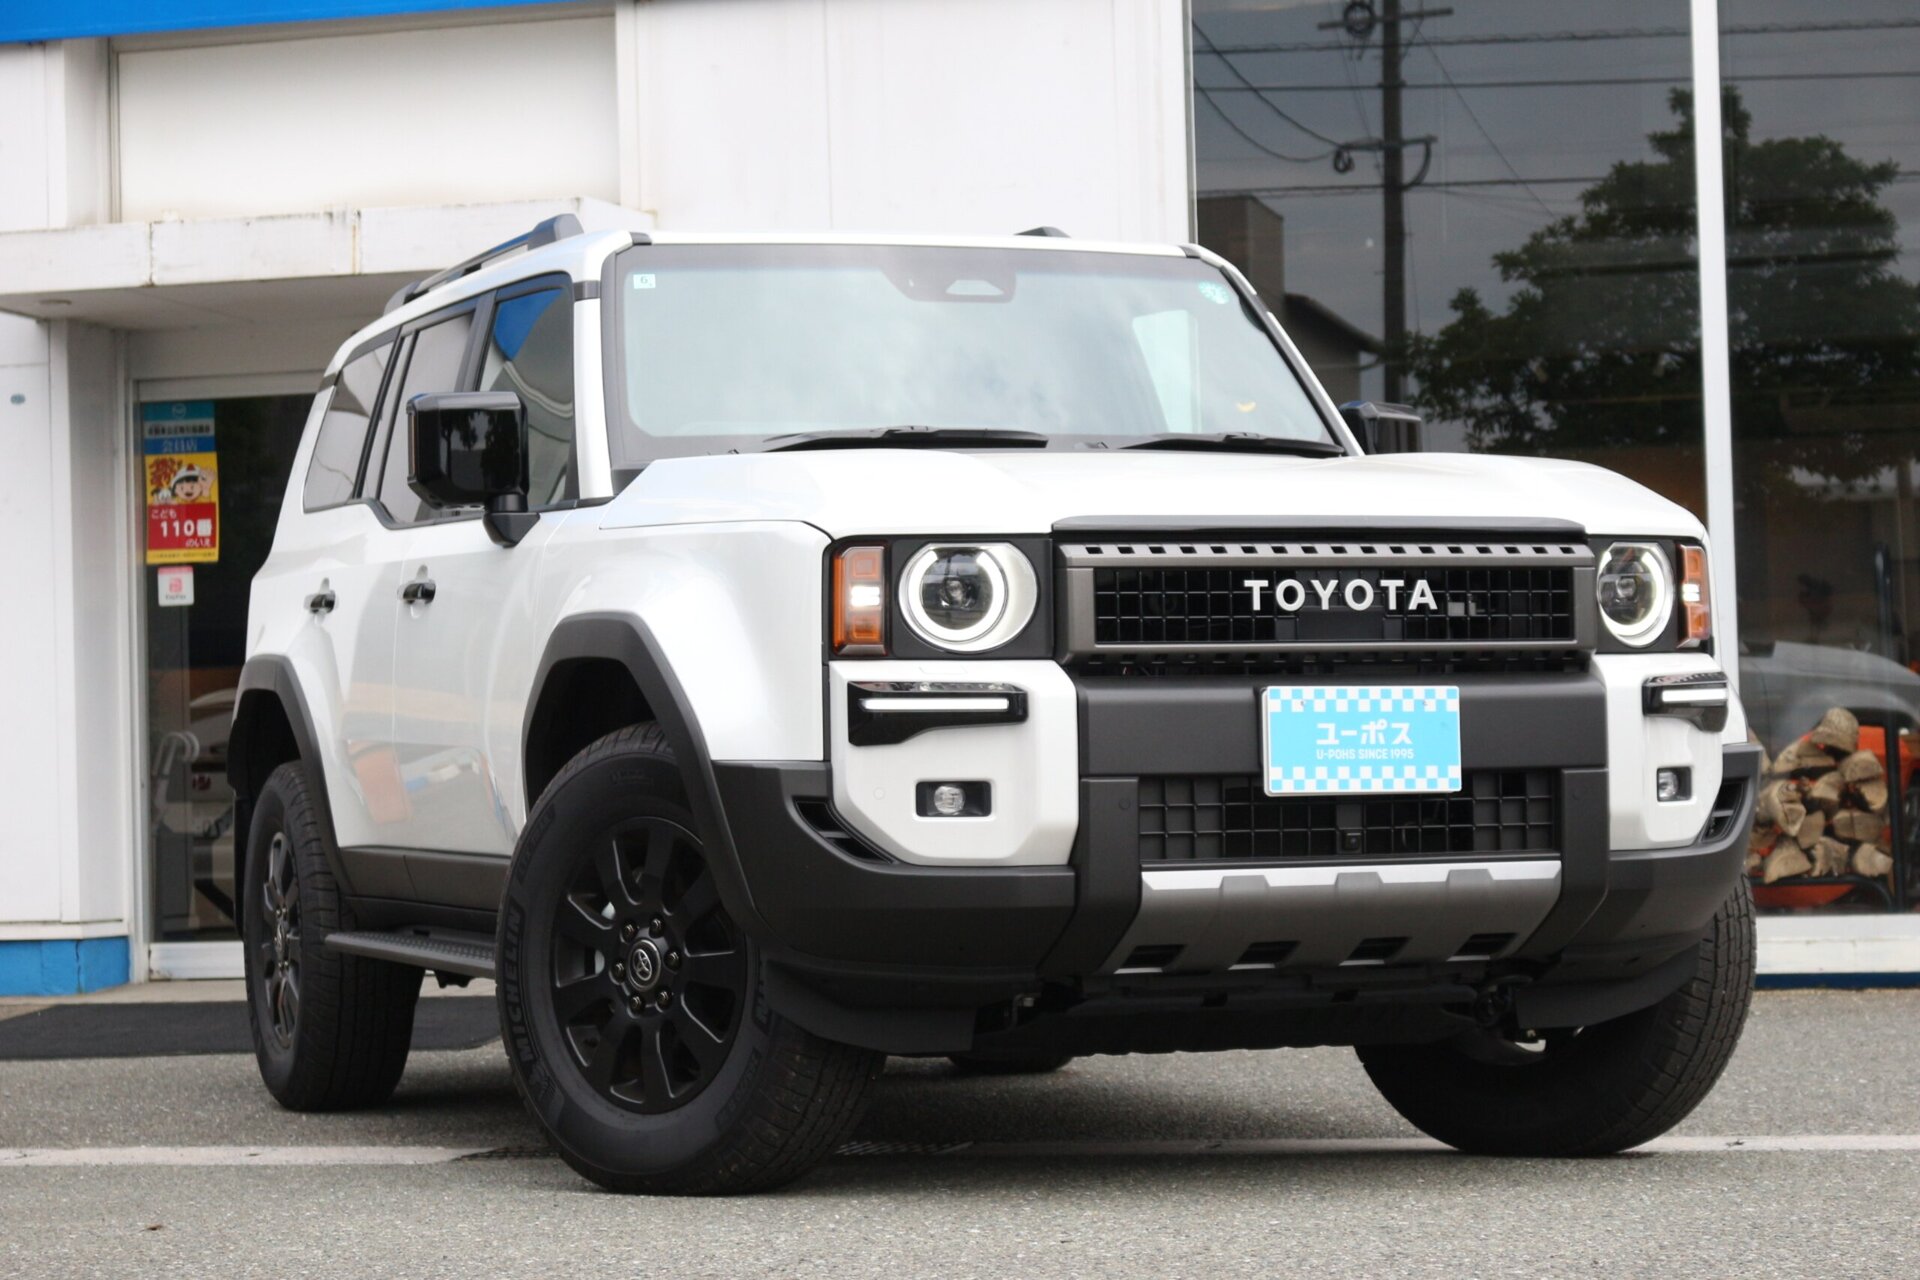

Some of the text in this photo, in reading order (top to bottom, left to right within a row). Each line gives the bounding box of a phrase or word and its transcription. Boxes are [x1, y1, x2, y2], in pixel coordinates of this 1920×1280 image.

[151, 508, 177, 519] こども
[185, 537, 212, 548] のいえ
[1244, 579, 1438, 611] TOYOTA
[1316, 719, 1413, 745] ユーポス
[1316, 748, 1414, 760] U-POHS SINCE 1995
[504, 905, 534, 1062] MICHELIN
